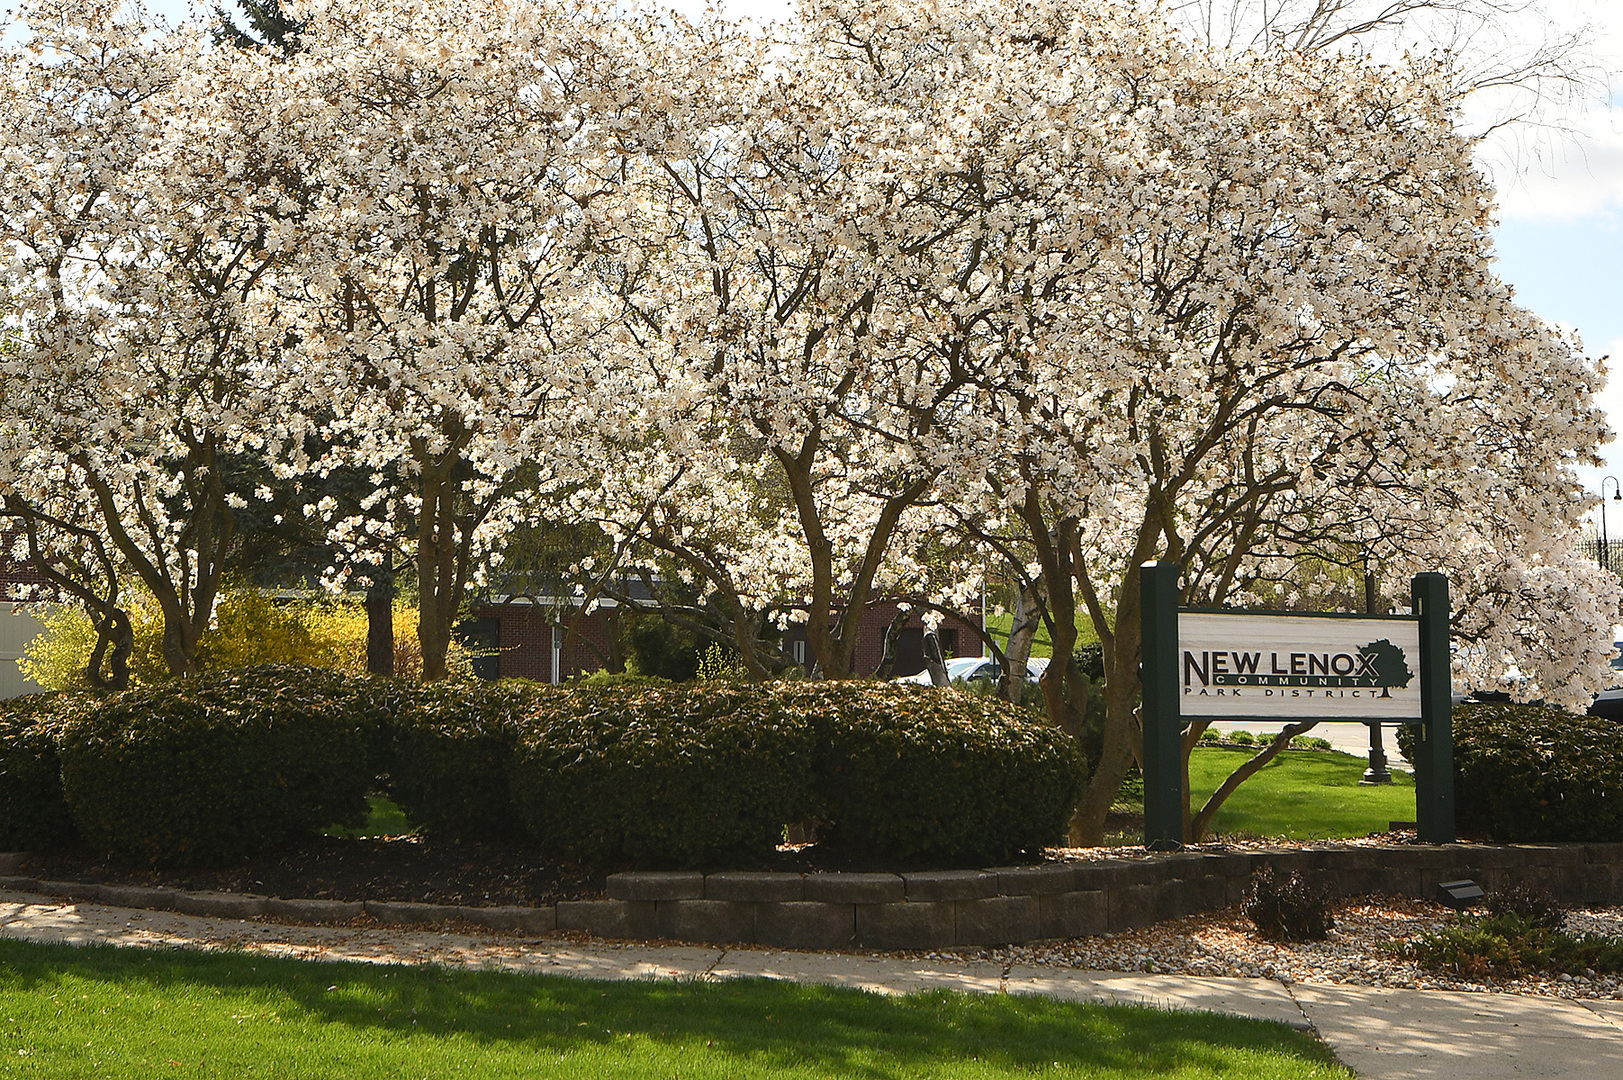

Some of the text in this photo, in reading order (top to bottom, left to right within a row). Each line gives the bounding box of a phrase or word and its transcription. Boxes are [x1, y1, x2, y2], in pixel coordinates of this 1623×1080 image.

[1184, 651, 1378, 686] NEW LENOX
[1216, 675, 1378, 686] COMMUNITY
[1184, 687, 1377, 698] PARK DISTRICT
